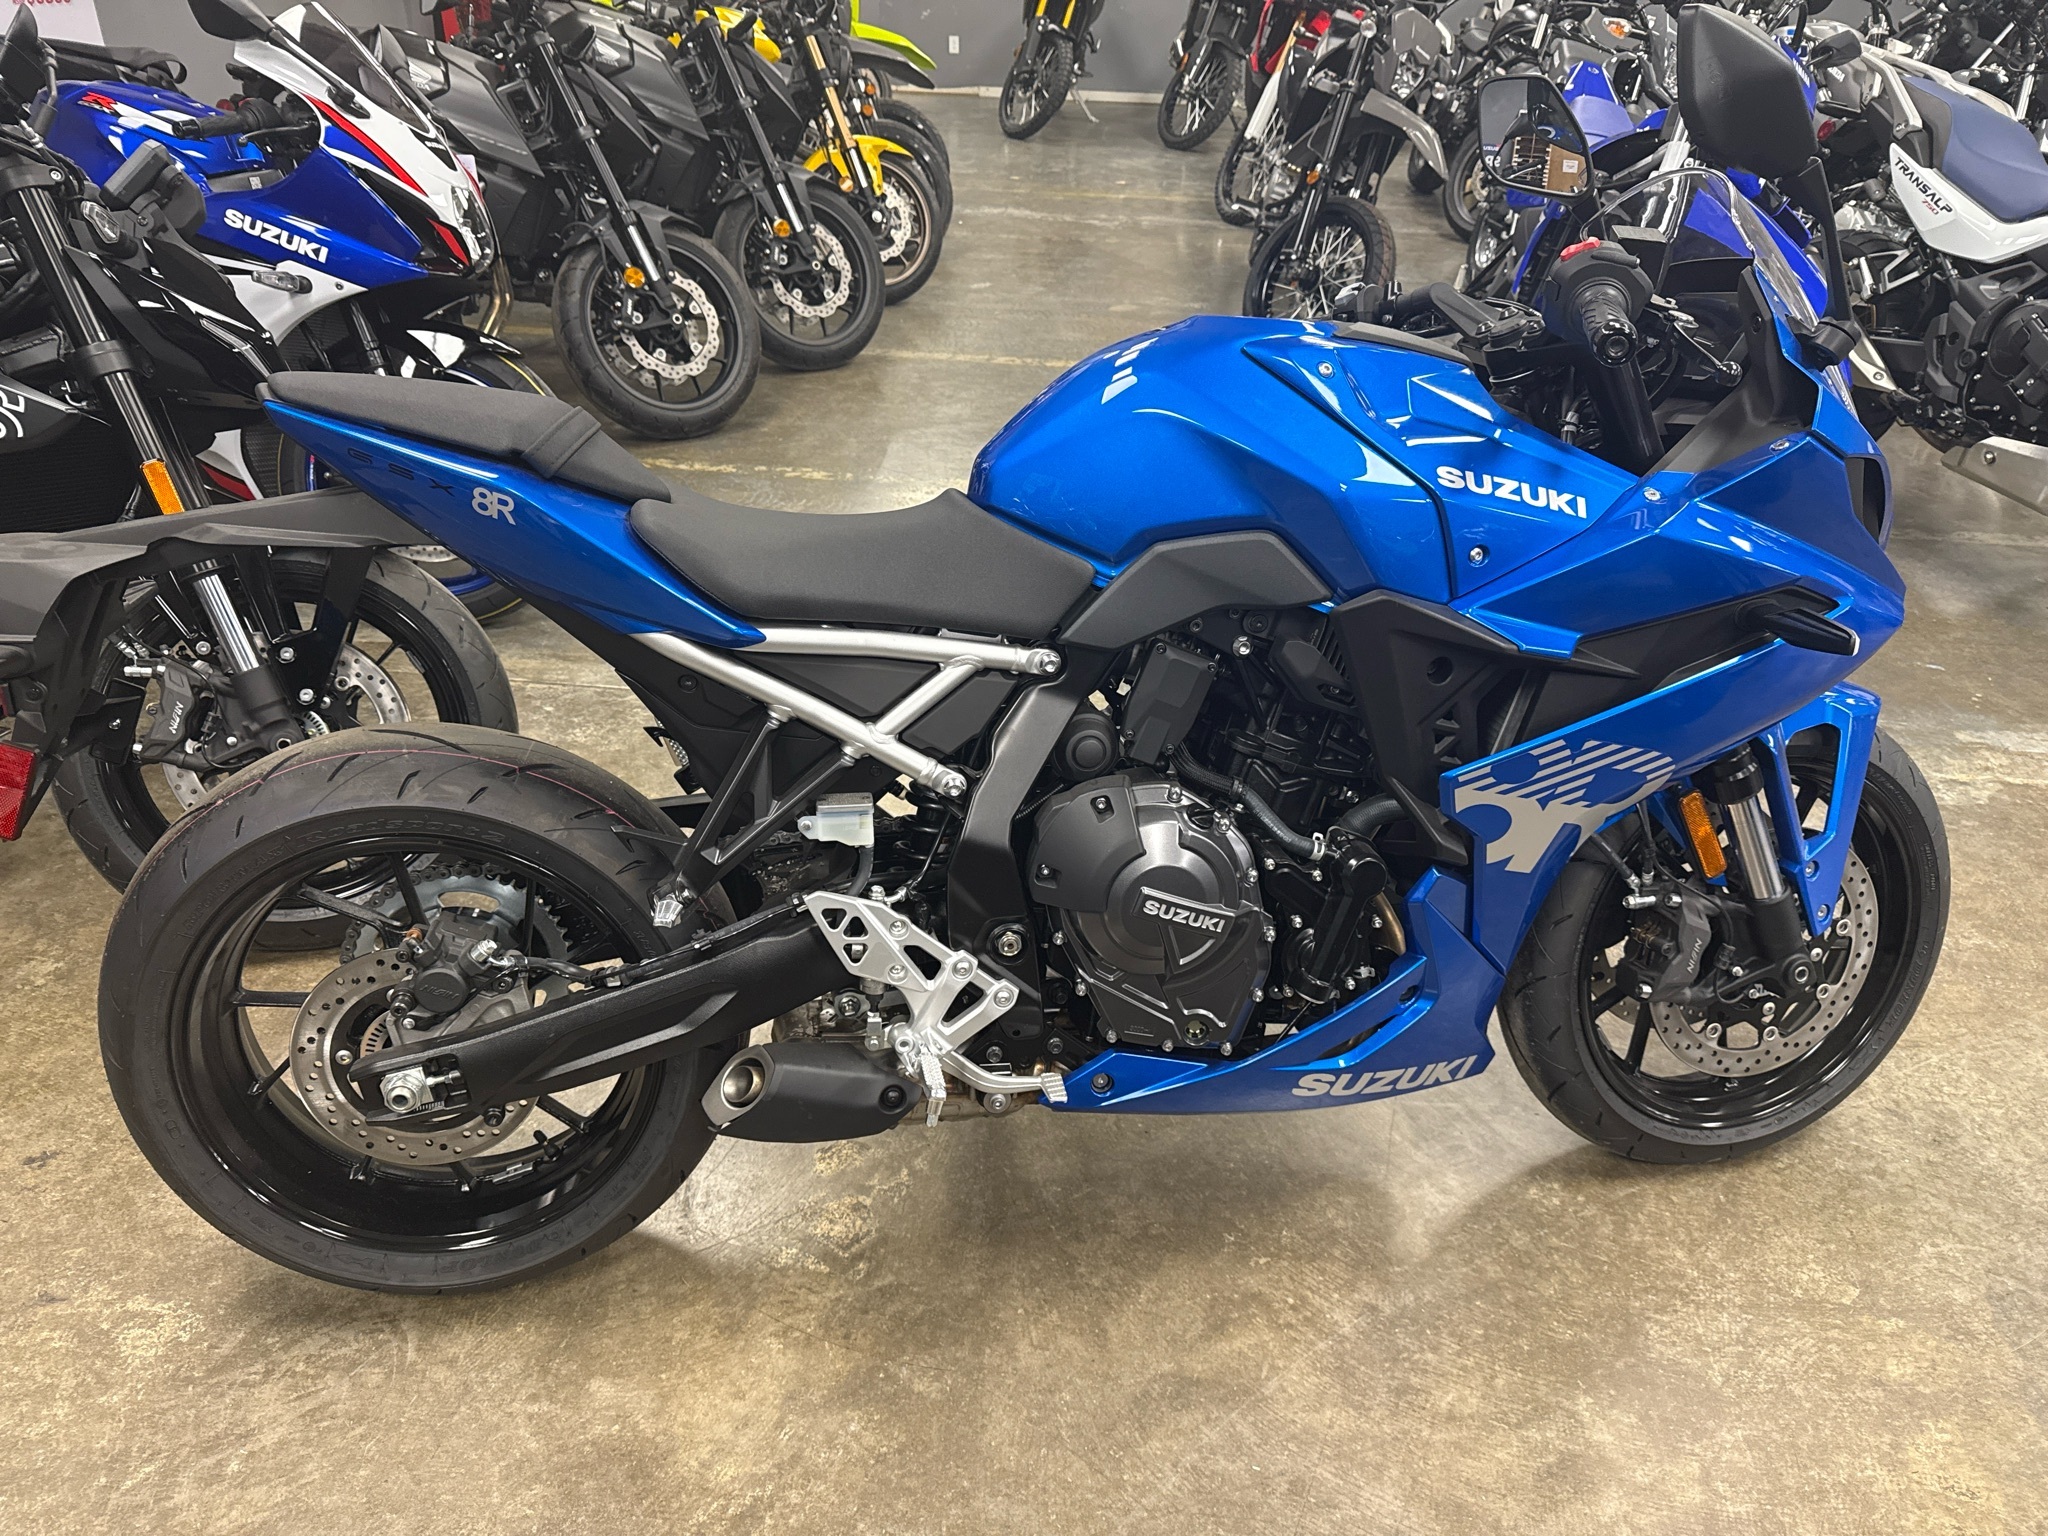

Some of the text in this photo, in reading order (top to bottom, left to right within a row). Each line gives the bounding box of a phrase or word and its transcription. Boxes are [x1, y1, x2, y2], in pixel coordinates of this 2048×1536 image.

[1894, 157, 1953, 213] TRANSALP
[223, 208, 329, 264] SUZUKI
[471, 487, 517, 526] 8R
[1436, 465, 1588, 519] SUZUKI
[1143, 899, 1226, 933] SUZUKI
[1291, 1055, 1479, 1098] SUZUKI
